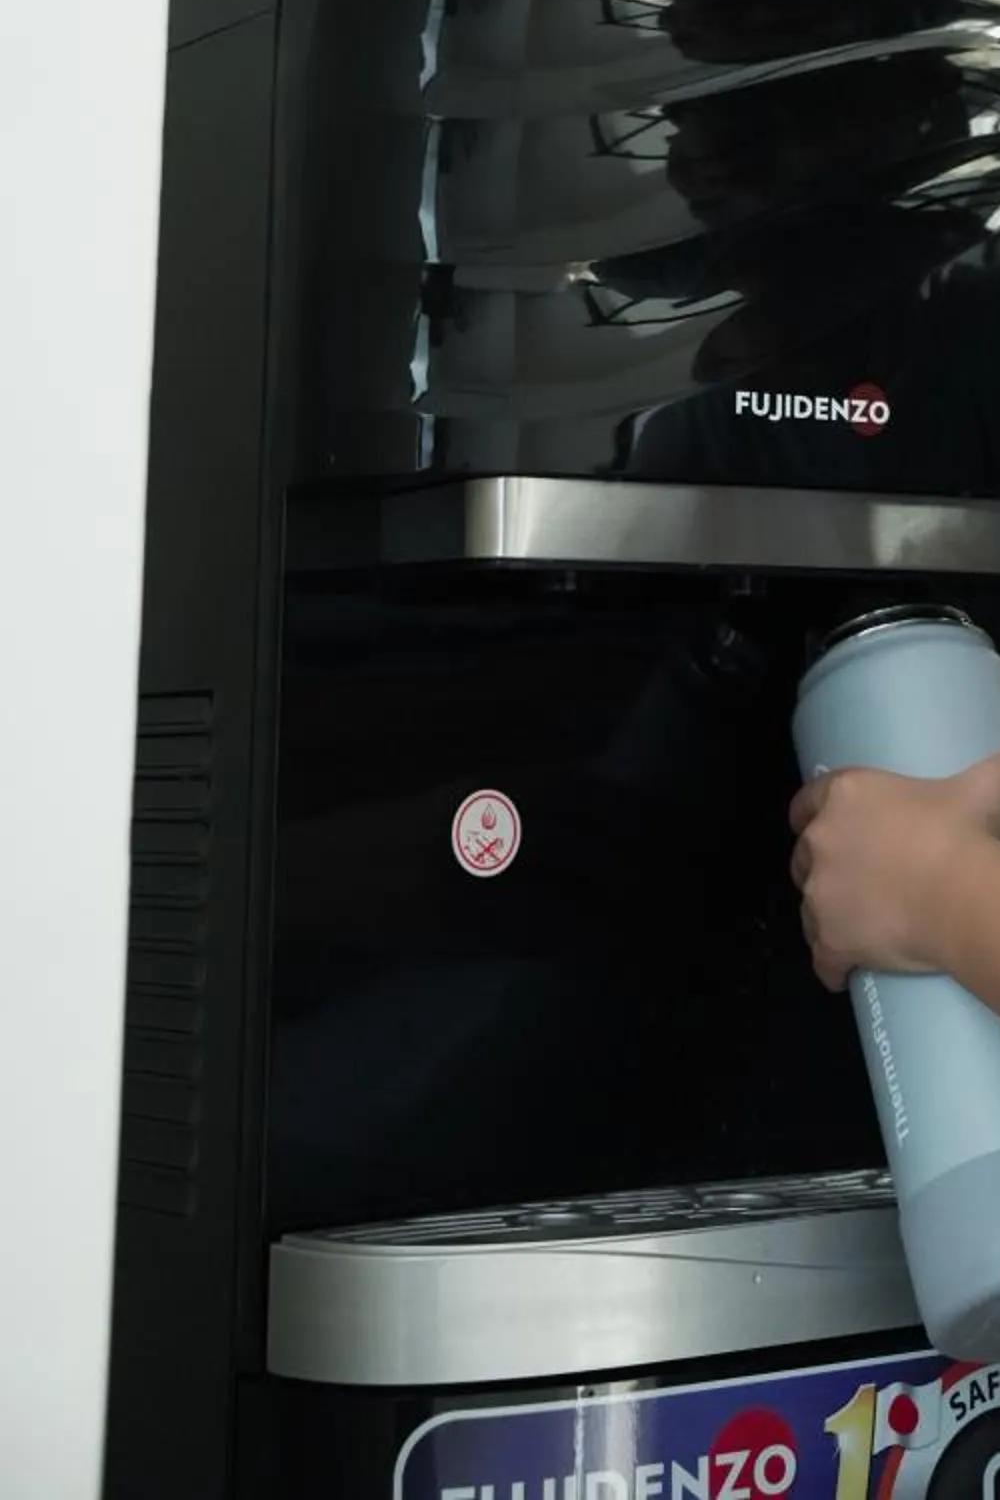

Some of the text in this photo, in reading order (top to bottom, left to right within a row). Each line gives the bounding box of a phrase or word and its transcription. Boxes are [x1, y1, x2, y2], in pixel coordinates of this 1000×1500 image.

[735, 390, 890, 424] FUJIDENZO
[862, 971, 910, 1148] ThermoFlask
[440, 1443, 797, 1500] IDENZO
